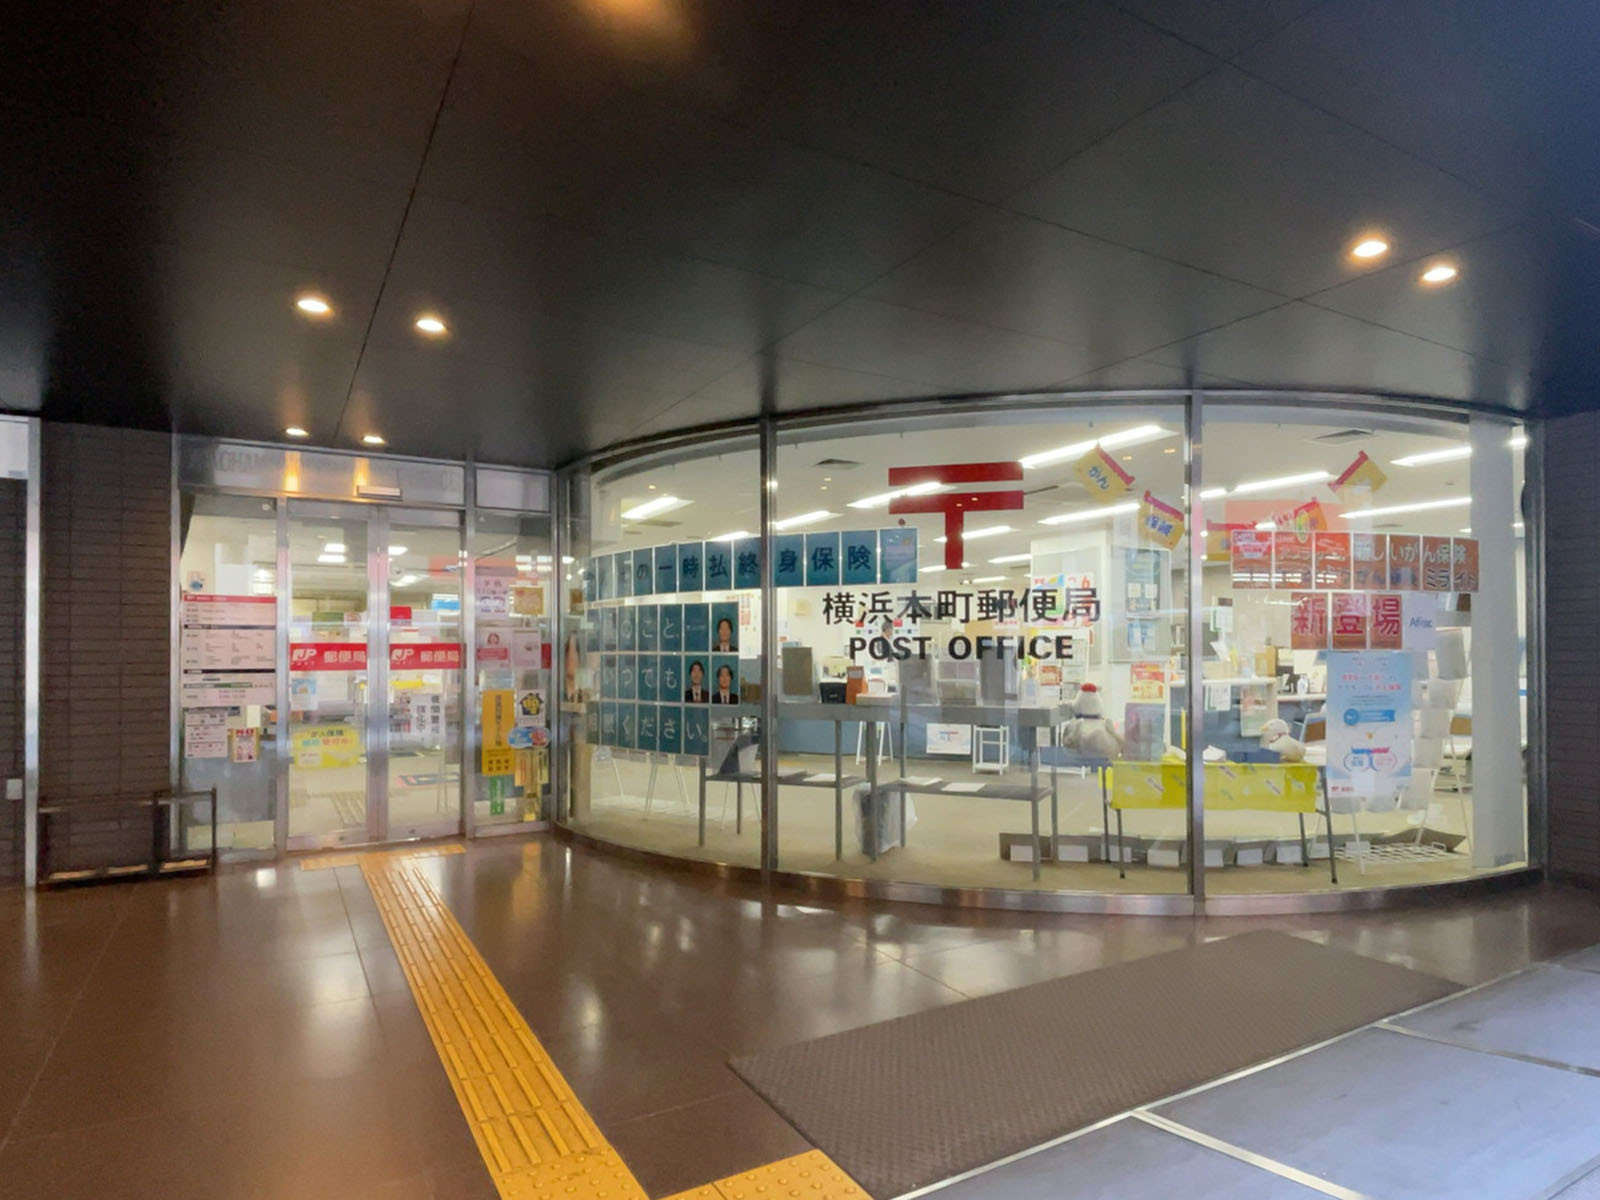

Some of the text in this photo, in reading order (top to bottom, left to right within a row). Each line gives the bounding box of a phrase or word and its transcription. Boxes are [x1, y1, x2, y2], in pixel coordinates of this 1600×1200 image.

[584, 545, 872, 584] の一時払終身保険
[822, 587, 1101, 624] 横浜本町郵便局
[1293, 597, 1401, 635] 新登場
[850, 635, 1073, 660] POST OFFICE
